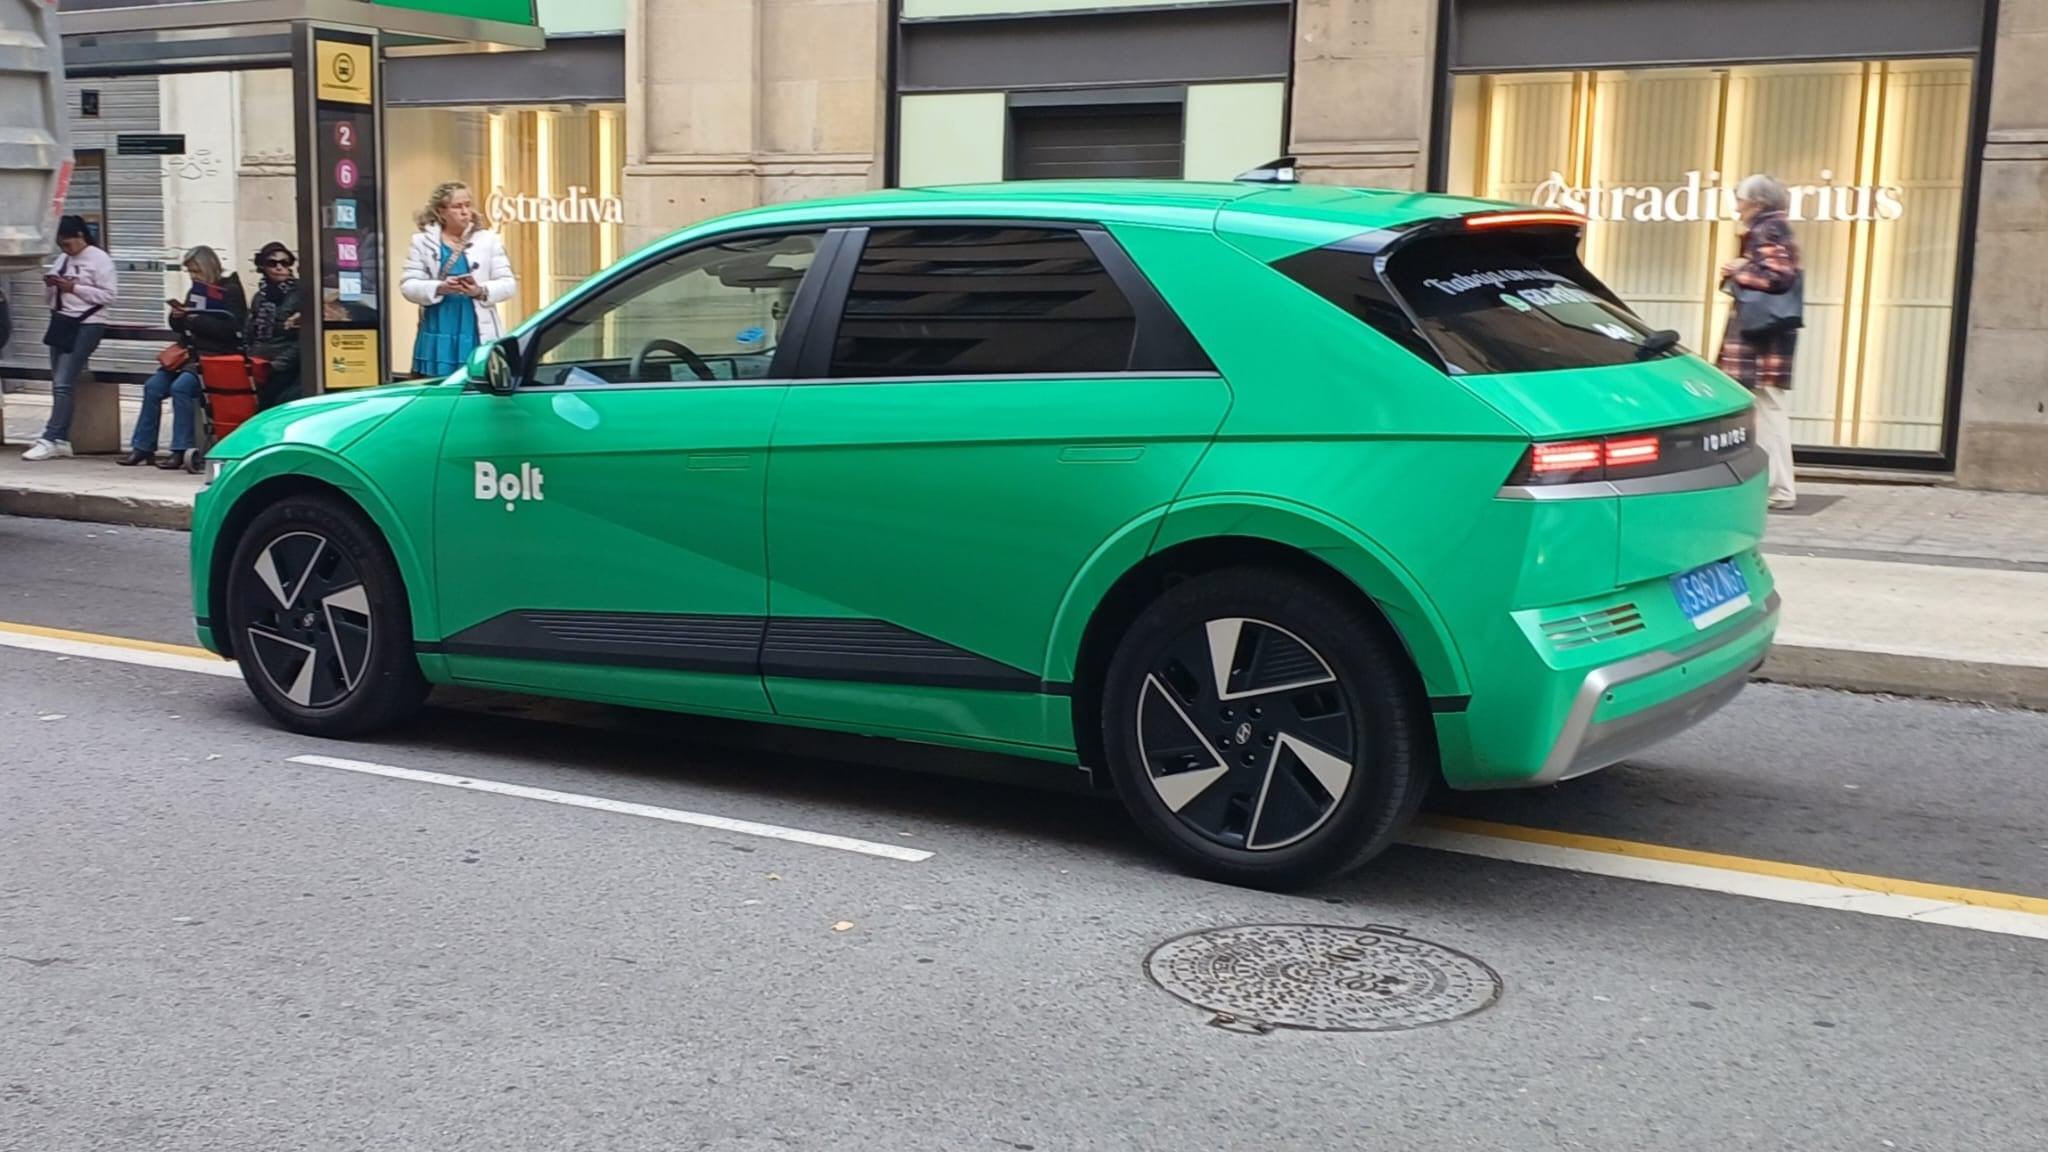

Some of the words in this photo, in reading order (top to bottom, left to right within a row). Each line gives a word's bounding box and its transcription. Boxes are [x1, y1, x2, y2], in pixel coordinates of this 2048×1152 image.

[339, 126, 352, 146] 2
[340, 164, 352, 184] 6
[474, 461, 544, 512] Bolt
